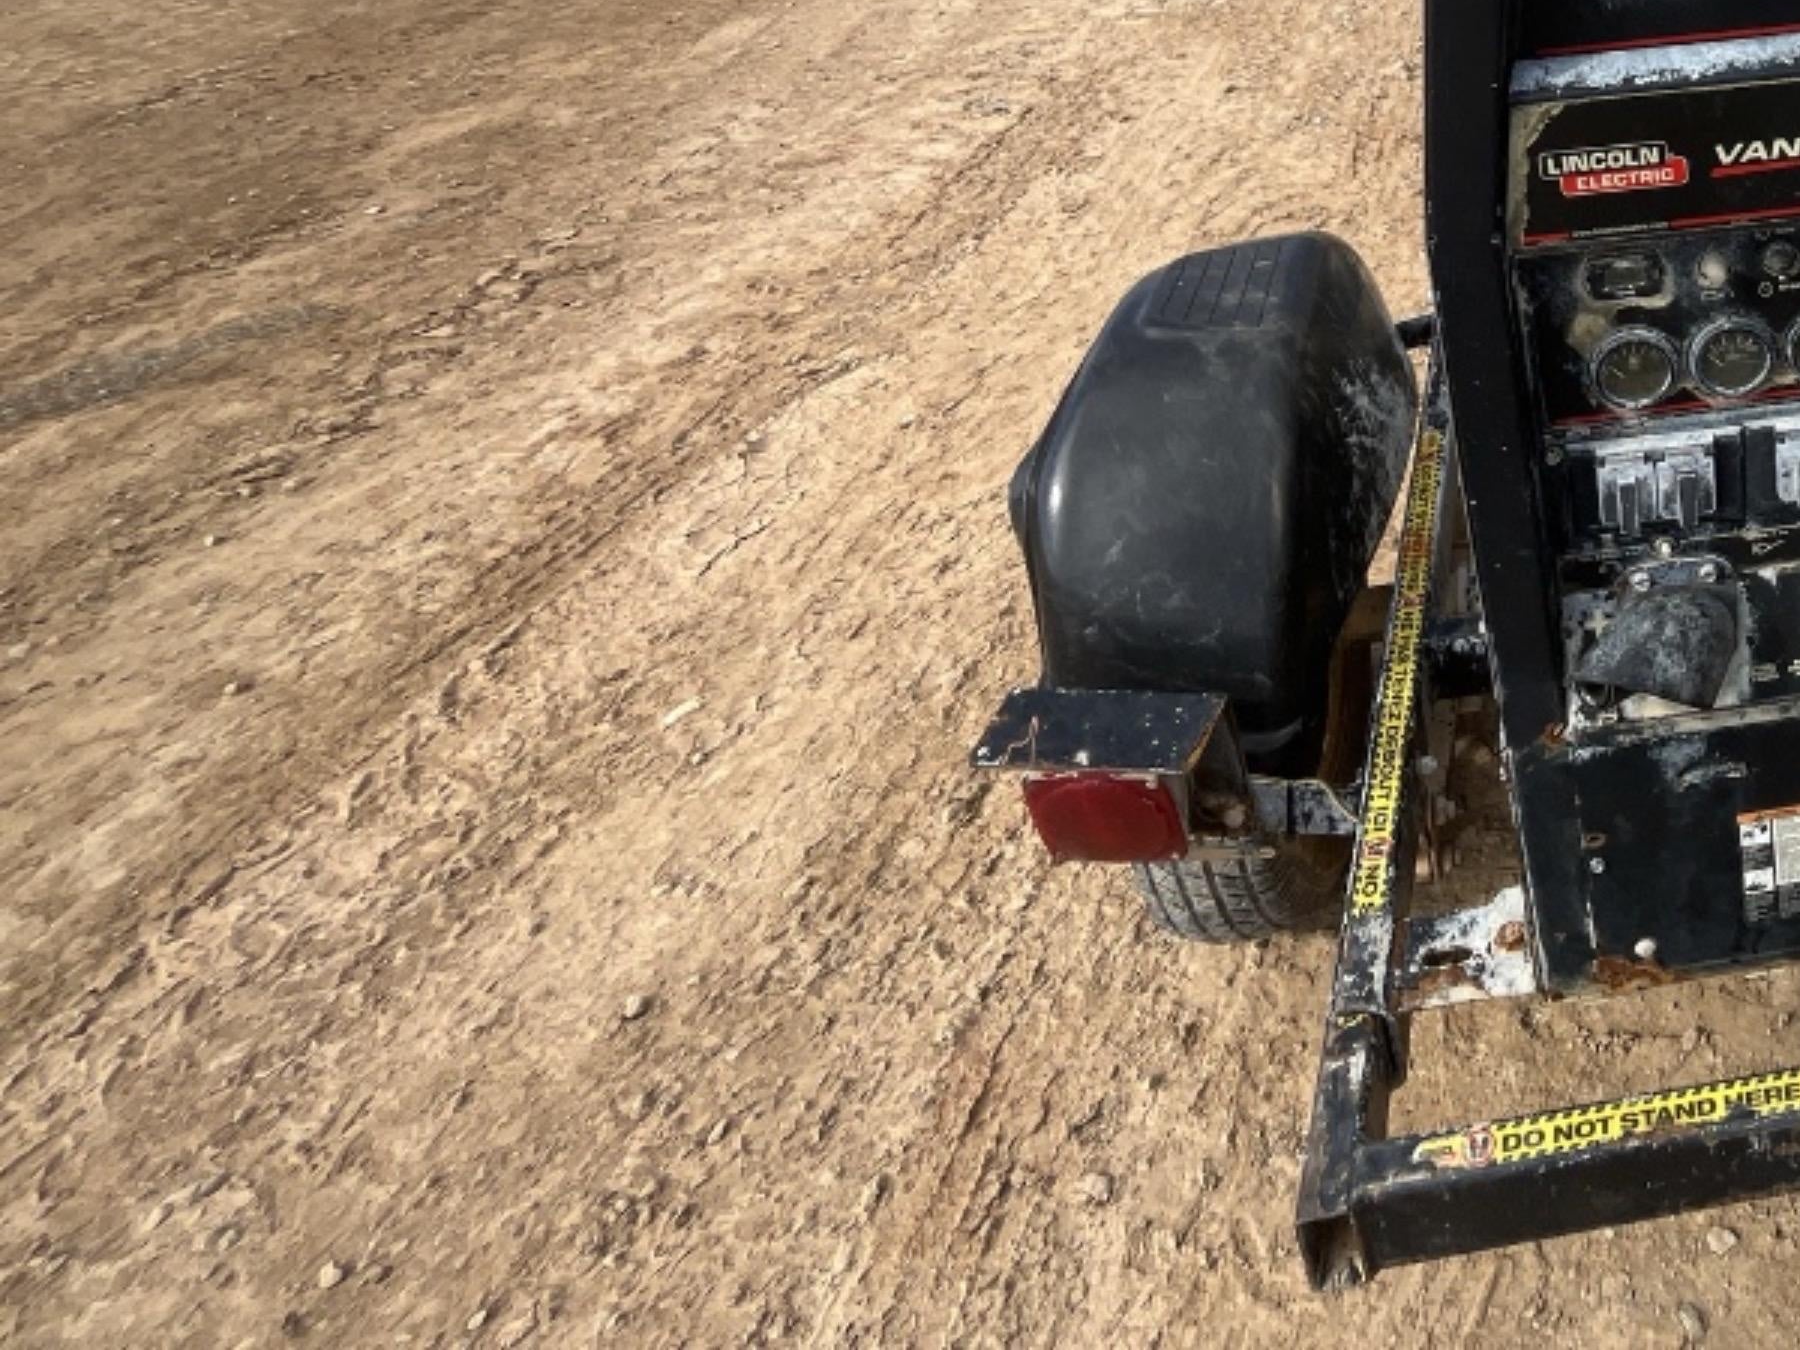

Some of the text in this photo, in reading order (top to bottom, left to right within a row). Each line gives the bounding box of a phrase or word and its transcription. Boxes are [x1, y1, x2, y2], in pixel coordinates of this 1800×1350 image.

[1547, 146, 1660, 175] LINCOLN
[1577, 168, 1675, 190] ELECTRIC
[1502, 1129, 1546, 1153] DO
[1553, 1116, 1615, 1144] NOT
[1619, 1095, 1718, 1131] STAND
